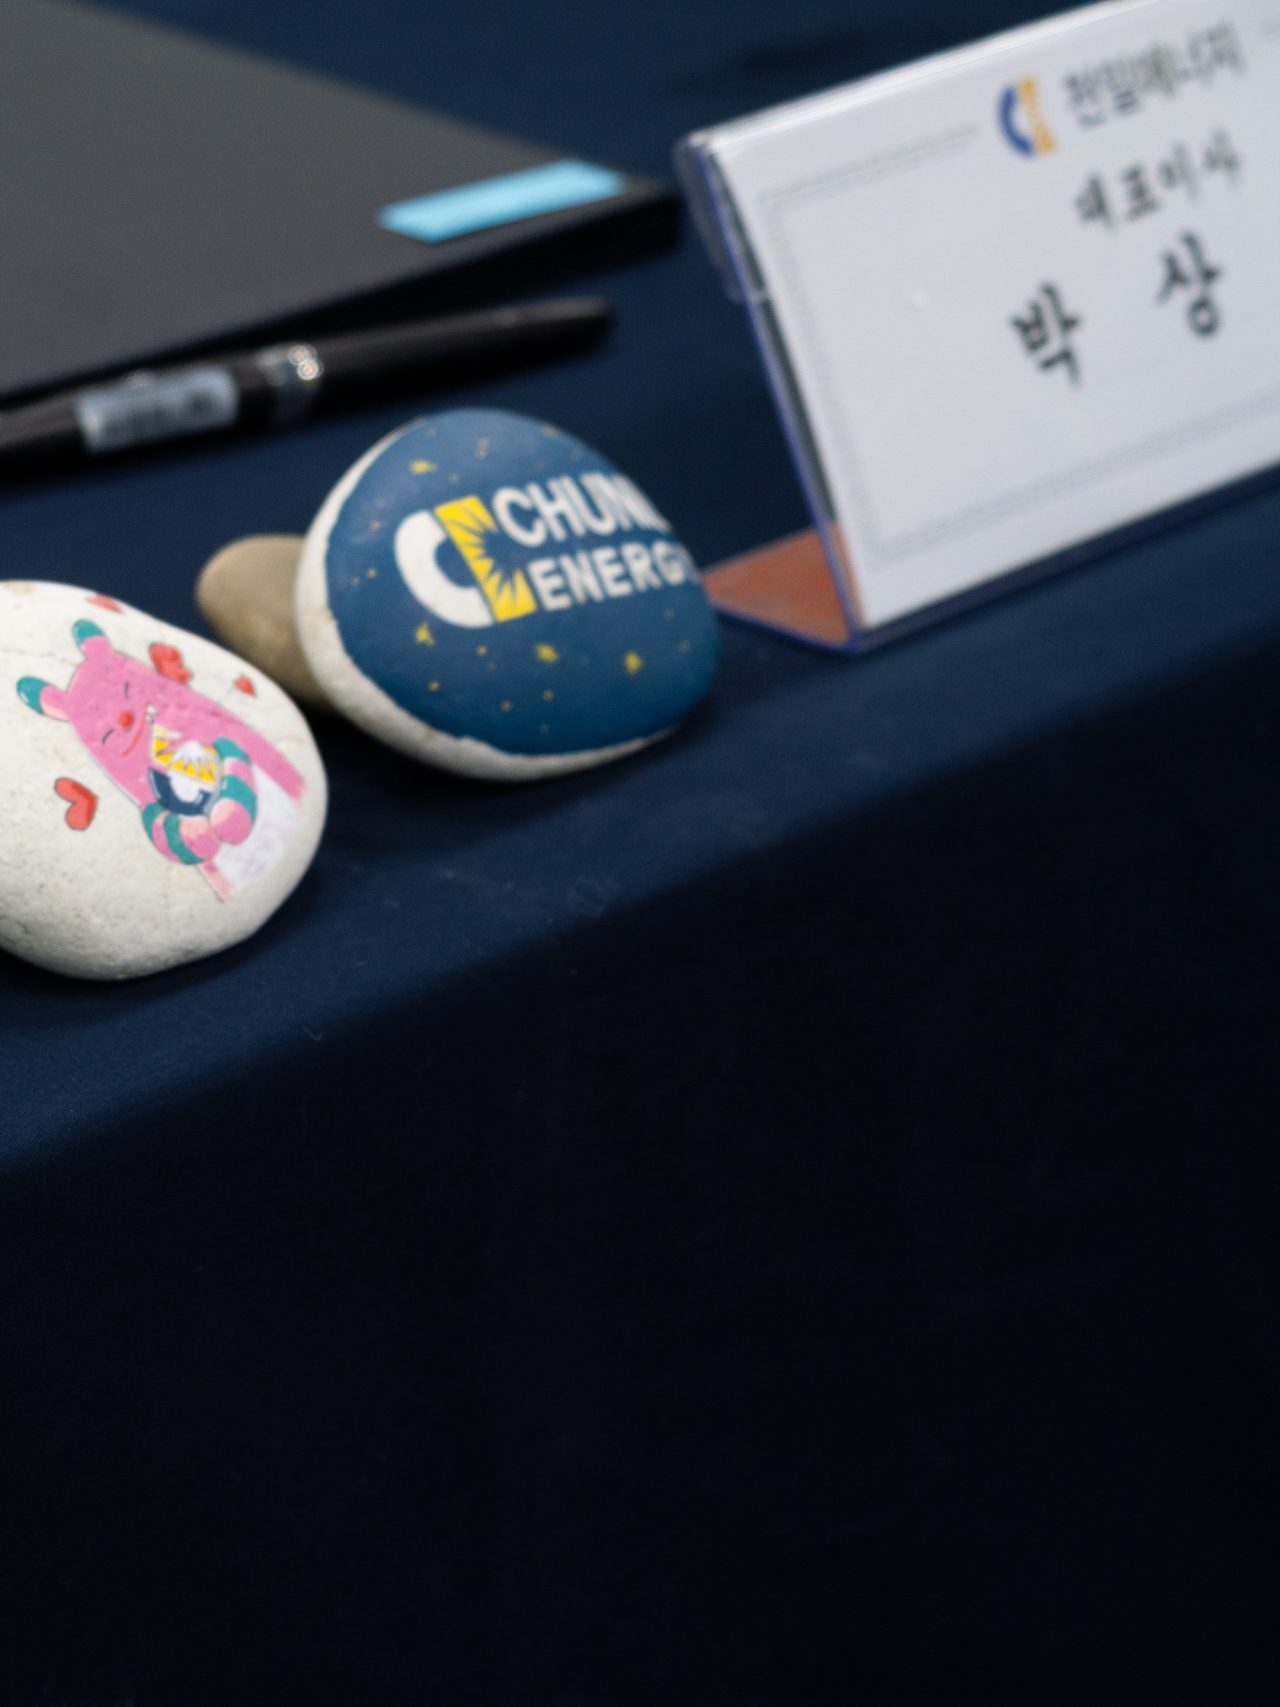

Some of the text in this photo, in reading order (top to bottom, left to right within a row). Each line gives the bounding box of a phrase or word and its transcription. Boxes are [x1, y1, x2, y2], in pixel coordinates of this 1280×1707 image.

[1074, 128, 1240, 230] 대표이사
[1010, 230, 1224, 387] 박 상
[493, 472, 672, 546] CHUN
